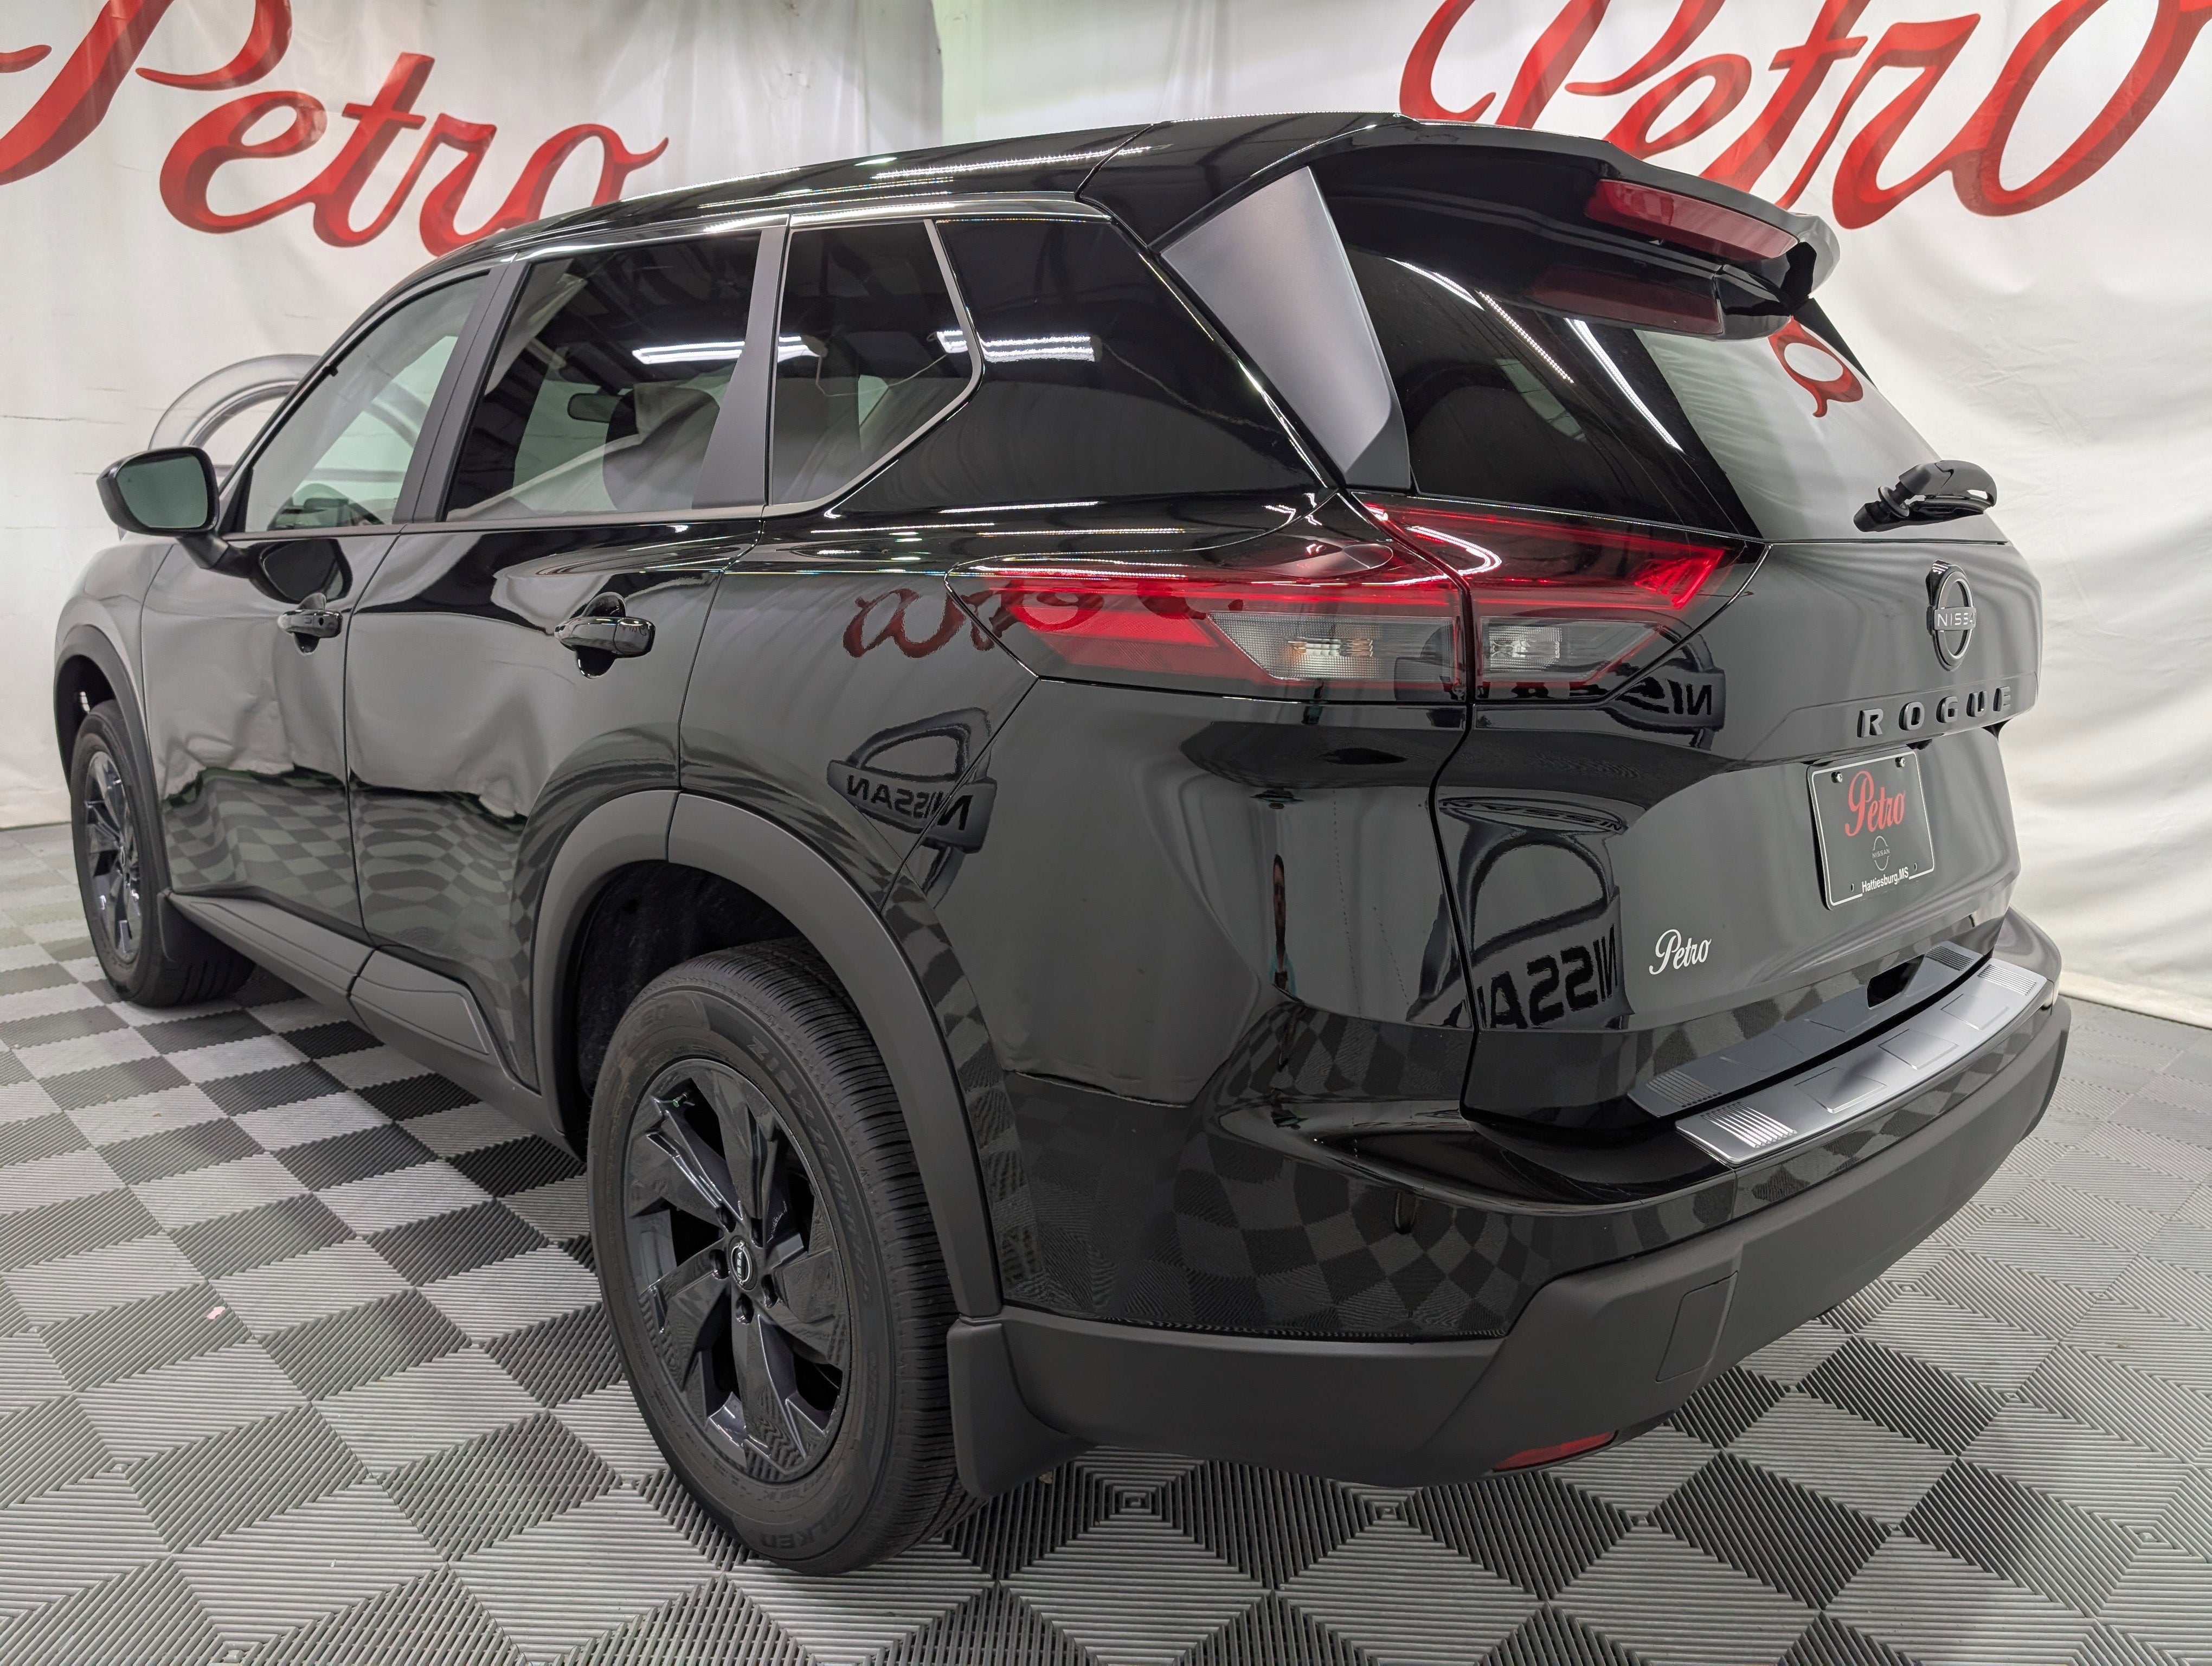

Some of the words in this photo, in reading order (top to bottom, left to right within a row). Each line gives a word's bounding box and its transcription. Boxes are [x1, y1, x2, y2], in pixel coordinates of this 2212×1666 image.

[1856, 685, 2011, 738] ROGUE
[1845, 770, 1906, 837] Petro
[1872, 848, 1890, 858] NISSAN
[1648, 928, 1712, 975] Petro
